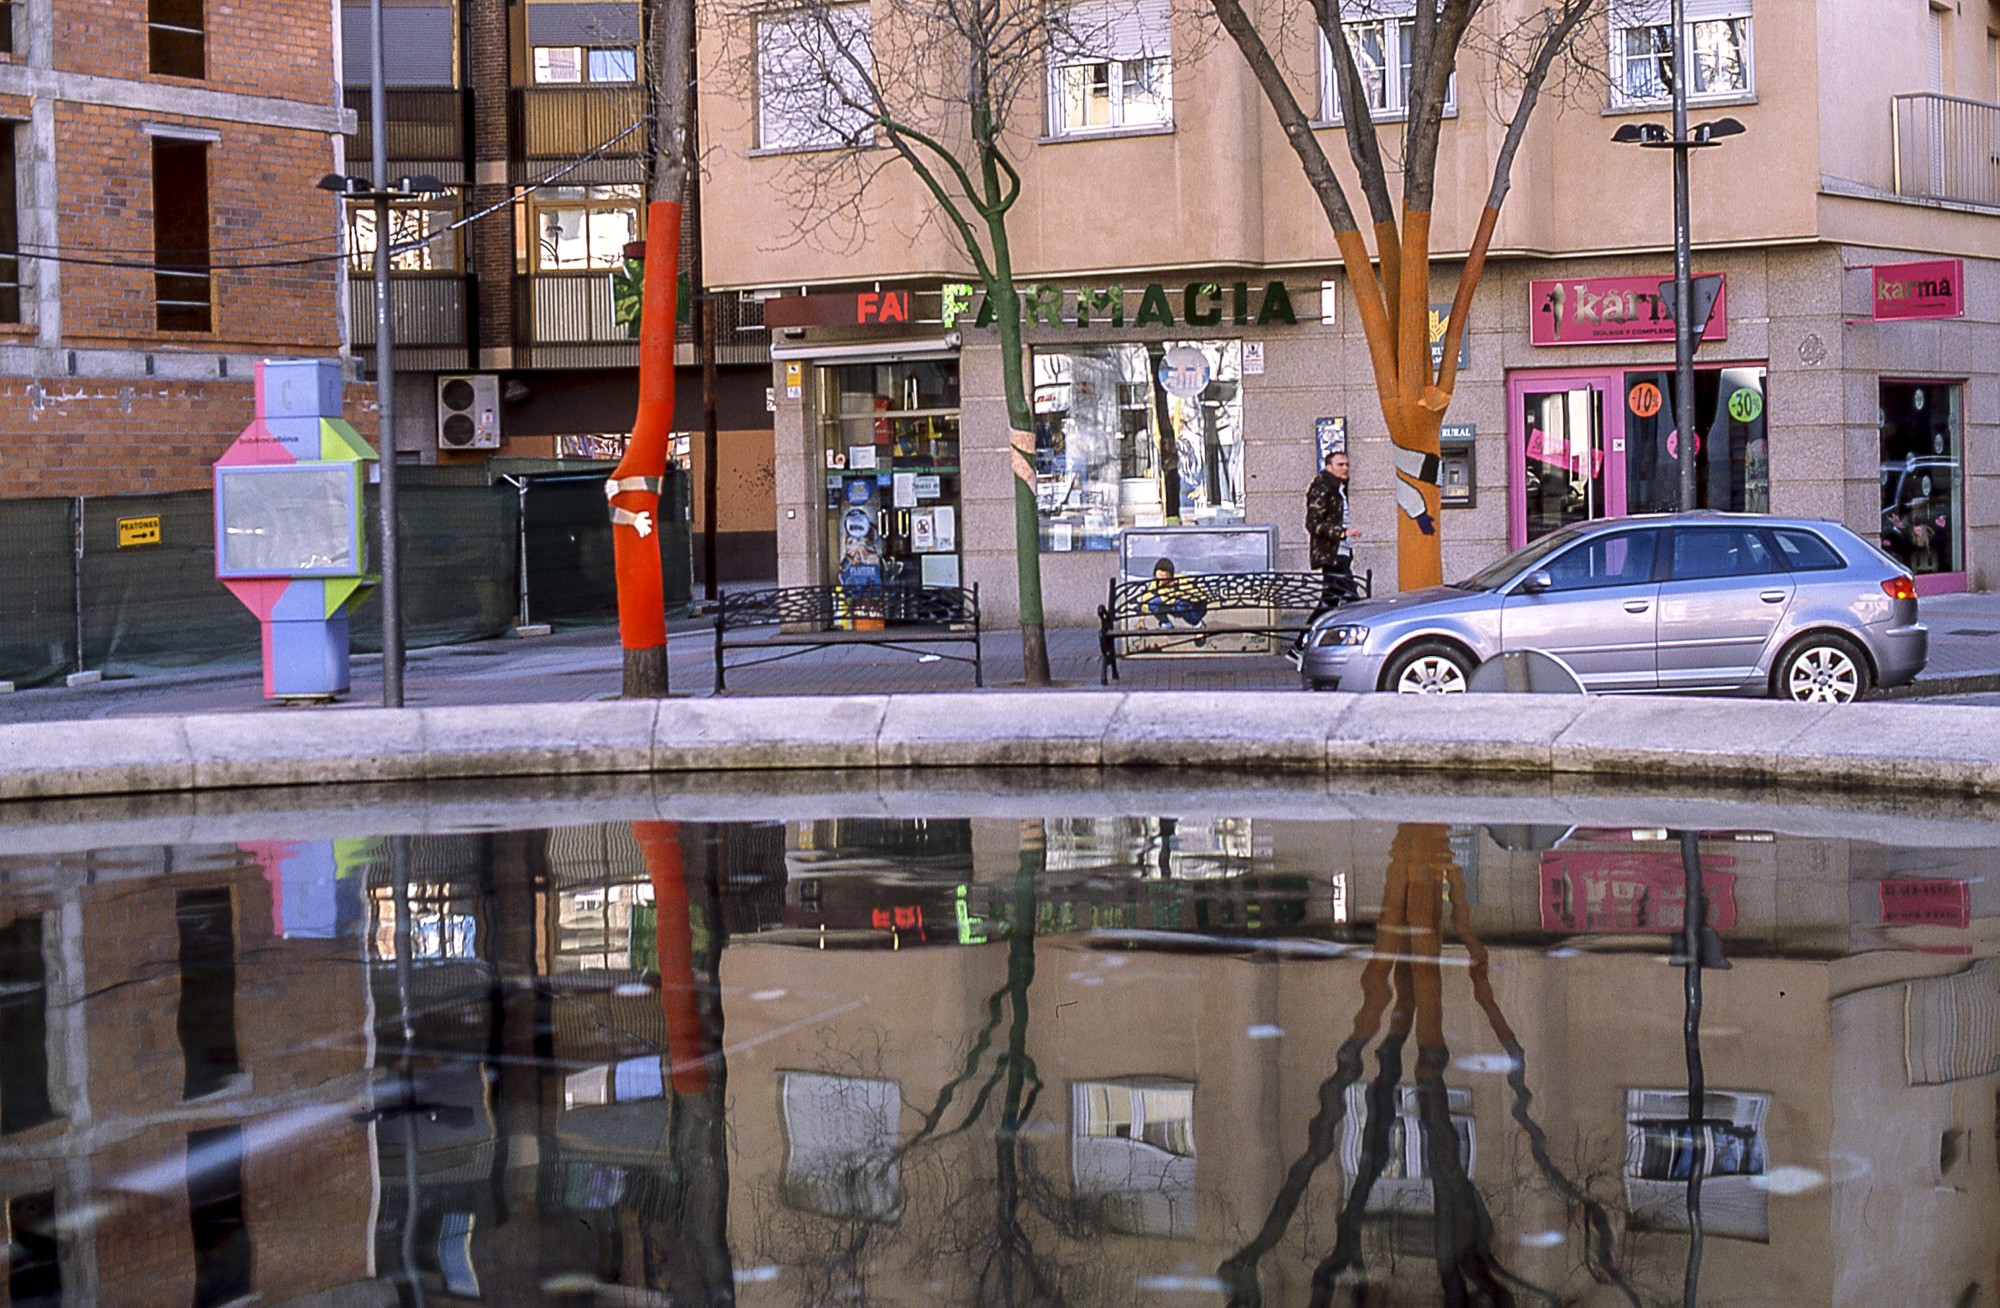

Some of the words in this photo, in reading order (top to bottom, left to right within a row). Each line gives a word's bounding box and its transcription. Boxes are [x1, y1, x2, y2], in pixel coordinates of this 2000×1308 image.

[1877, 276, 1952, 301] karma
[857, 291, 908, 324] FA
[1632, 327, 1675, 335] COMPLEME
[1731, 392, 1760, 417] -30%
[1441, 428, 1471, 437] RURAL
[120, 521, 158, 530] PEATONES
